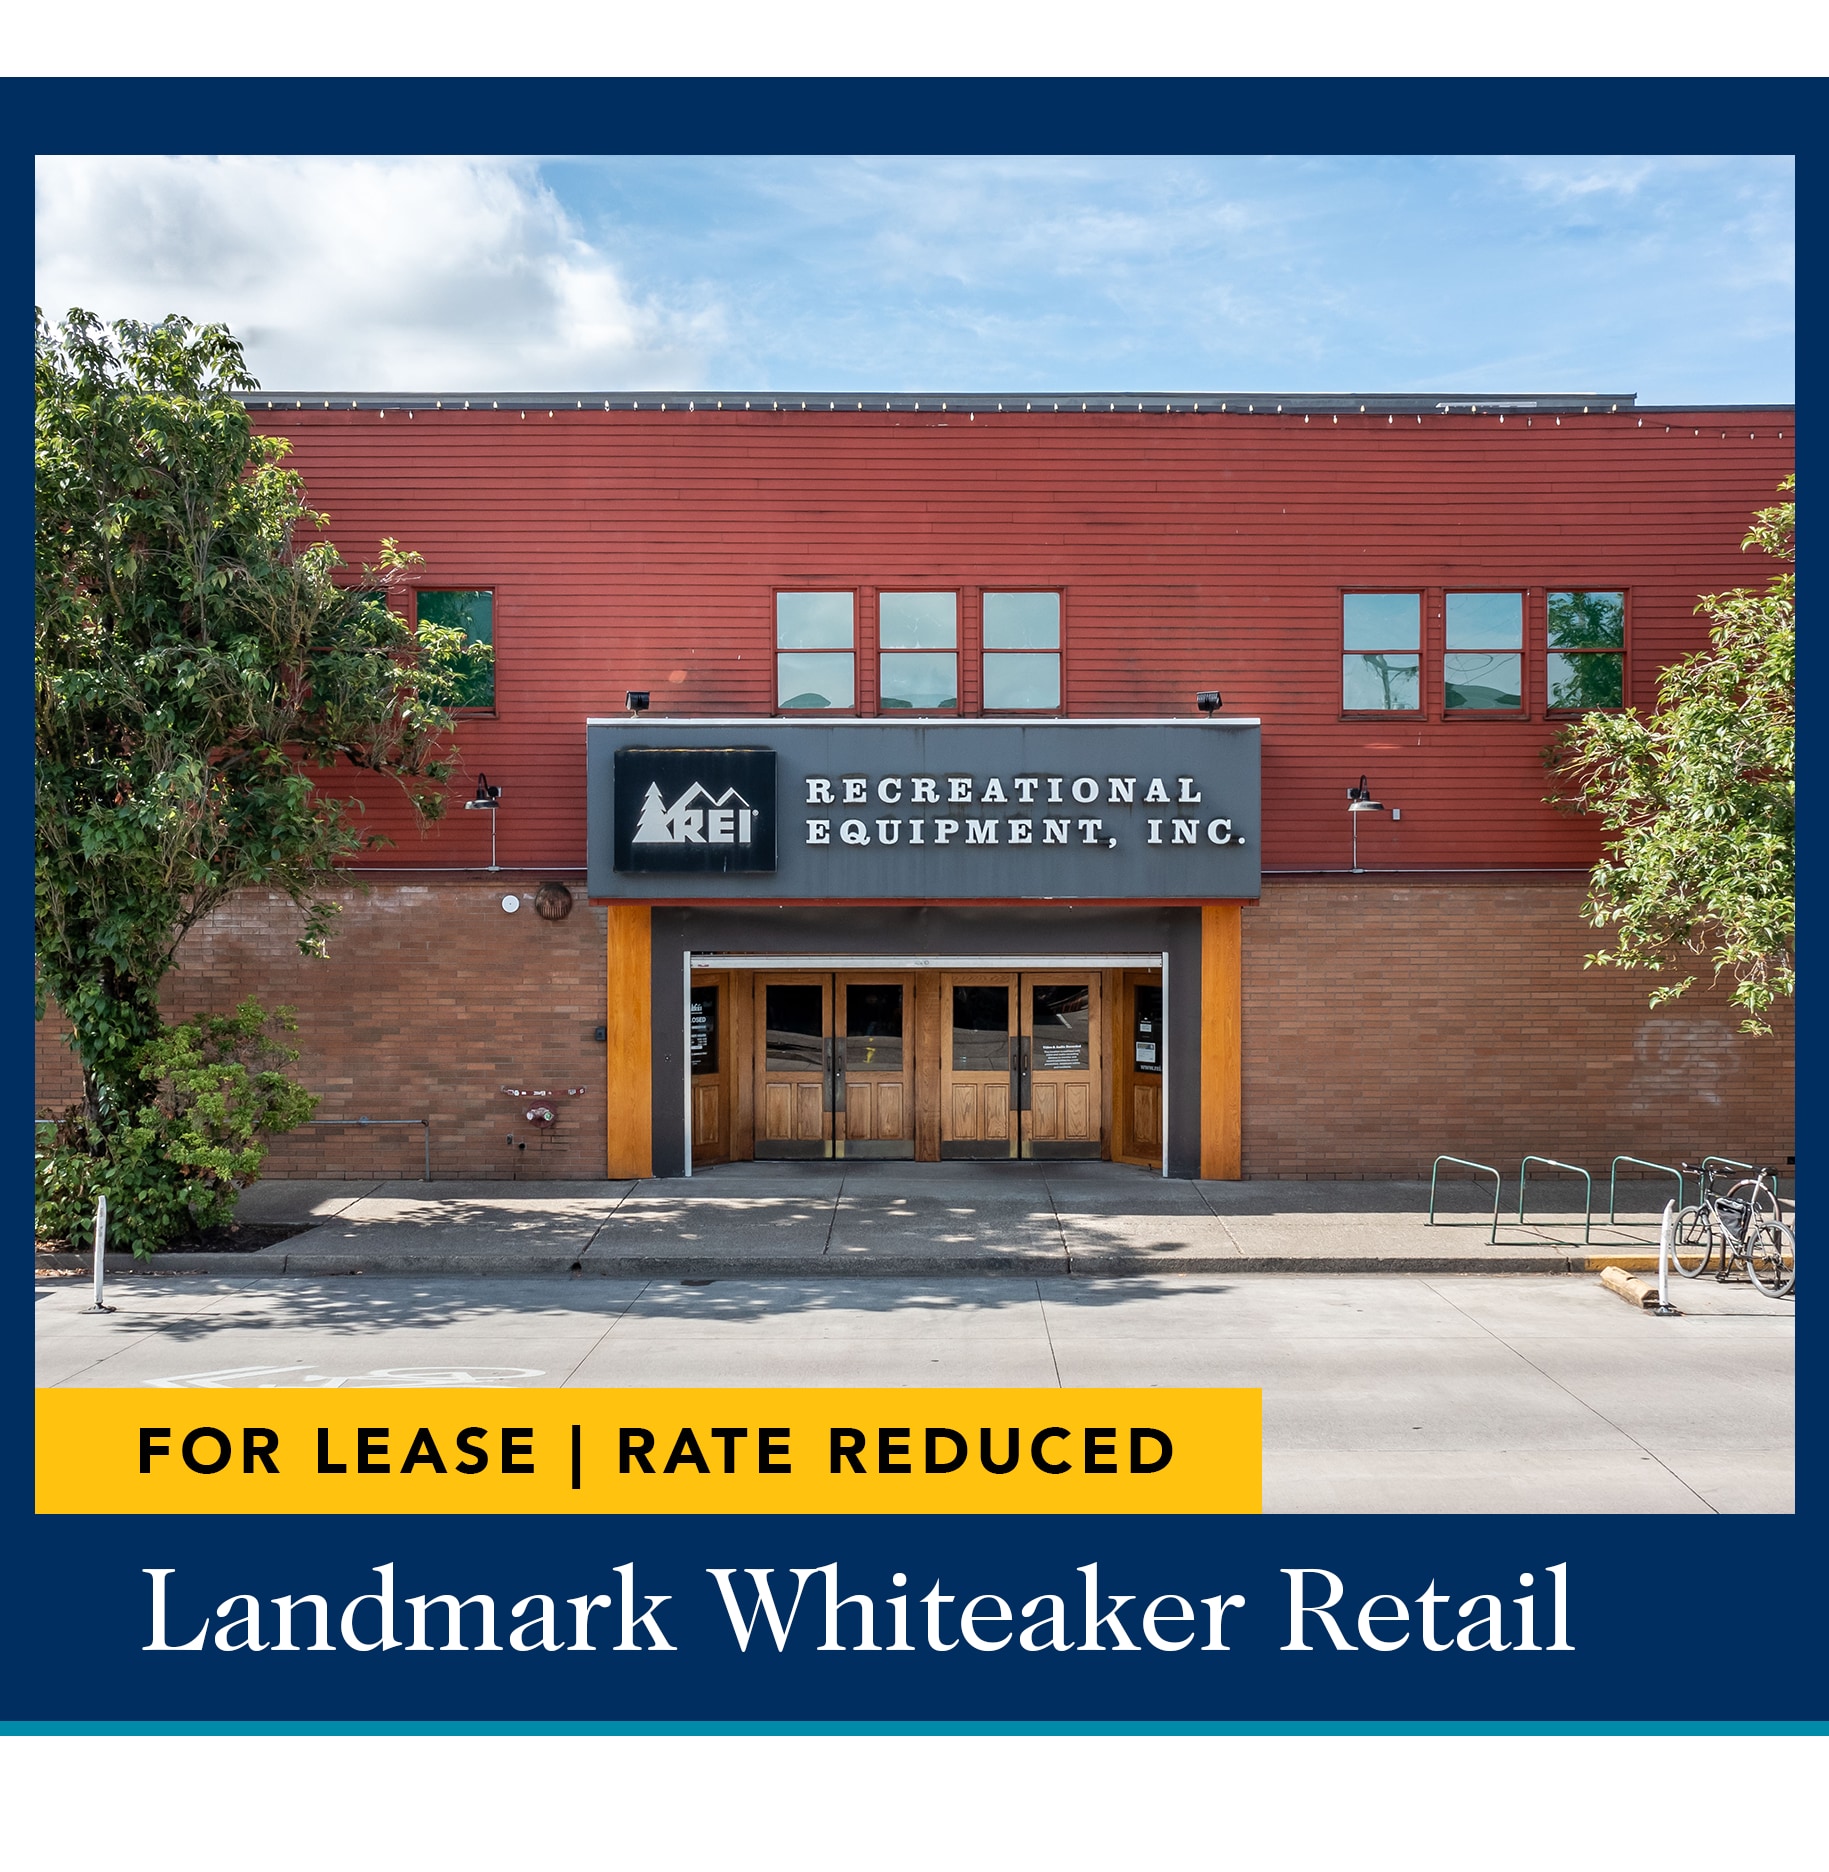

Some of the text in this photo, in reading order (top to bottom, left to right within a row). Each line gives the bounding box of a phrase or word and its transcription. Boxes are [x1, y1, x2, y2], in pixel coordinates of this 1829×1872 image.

[805, 777, 1202, 804] RECREATIONAL
[673, 808, 752, 843] REI
[805, 819, 1246, 849] EQUIPMENT, INC.
